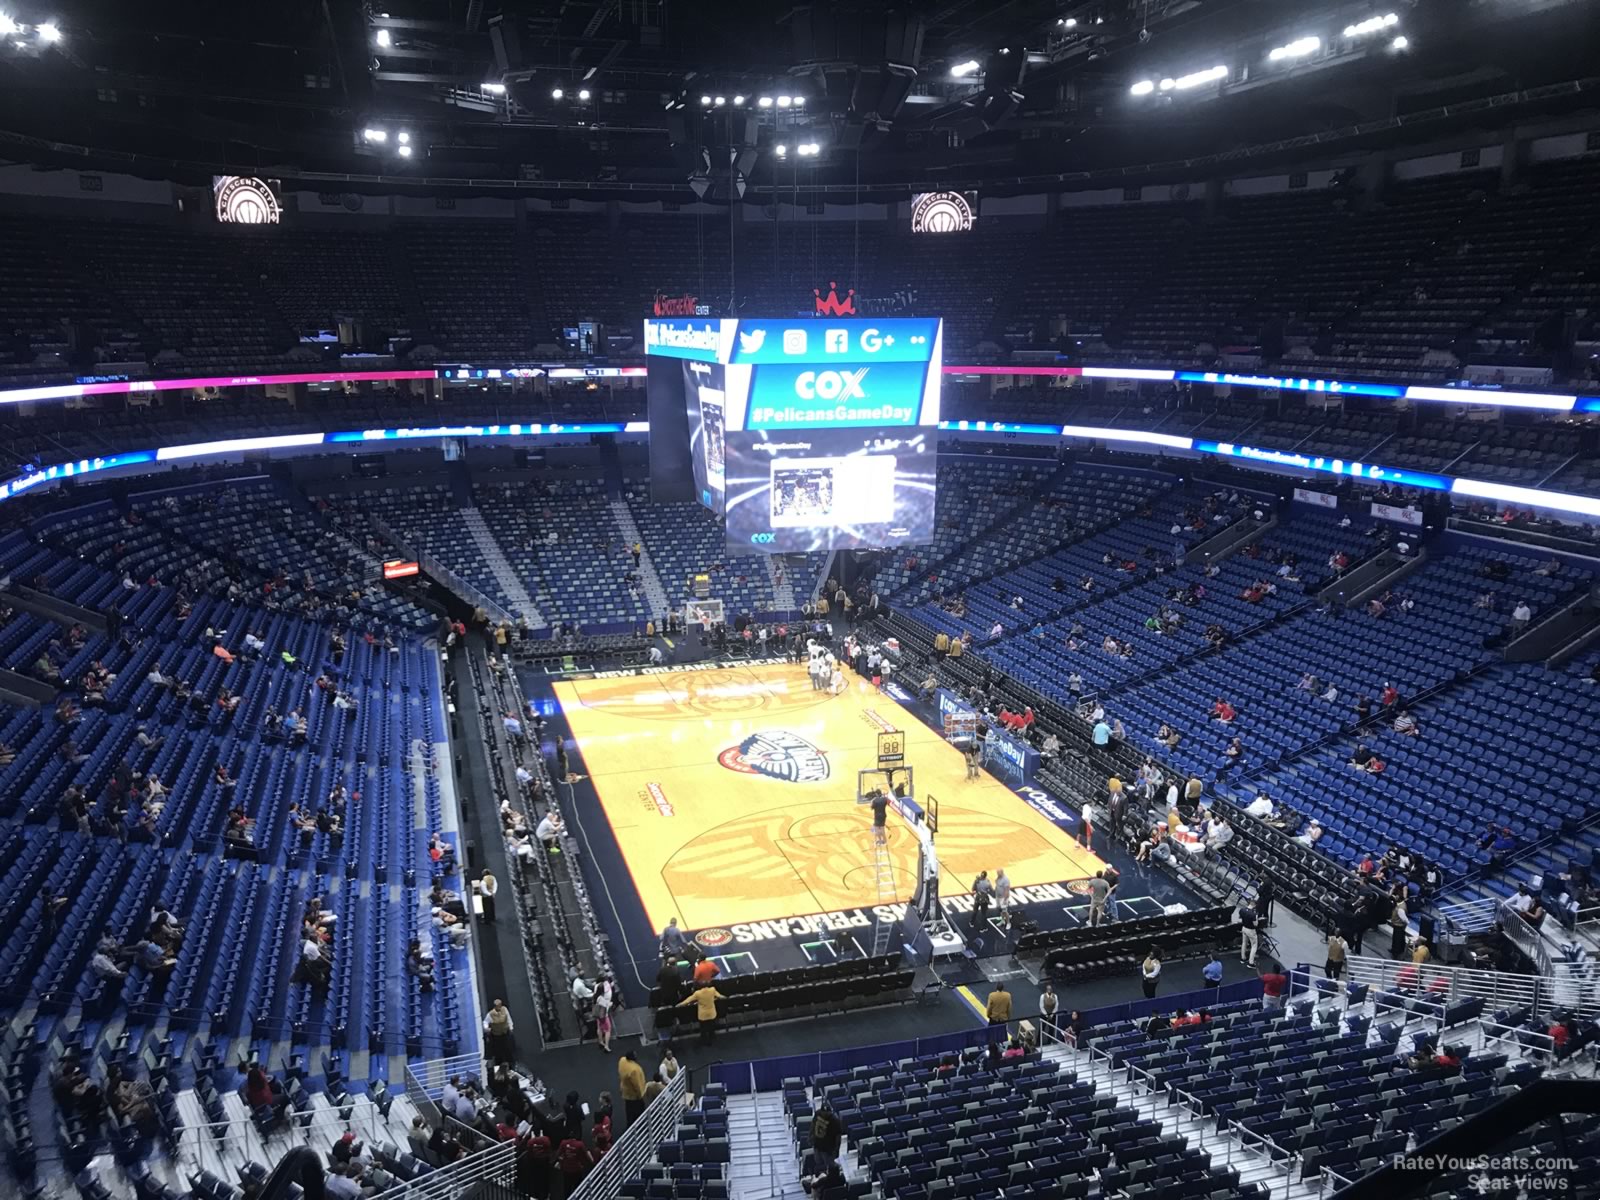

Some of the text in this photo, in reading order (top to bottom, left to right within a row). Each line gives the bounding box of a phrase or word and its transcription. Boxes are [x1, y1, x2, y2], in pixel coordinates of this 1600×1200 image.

[221, 178, 275, 208] CRESCENT CITY
[916, 193, 969, 221] CRESCENT CITY
[795, 367, 871, 404] COX
[752, 404, 912, 423] #PelicansGameDay
[751, 532, 776, 544] COX
[594, 656, 791, 679] NEW ORLEANS PELICAN
[1009, 883, 1074, 907] NEW
[731, 908, 872, 943] PELICANS
